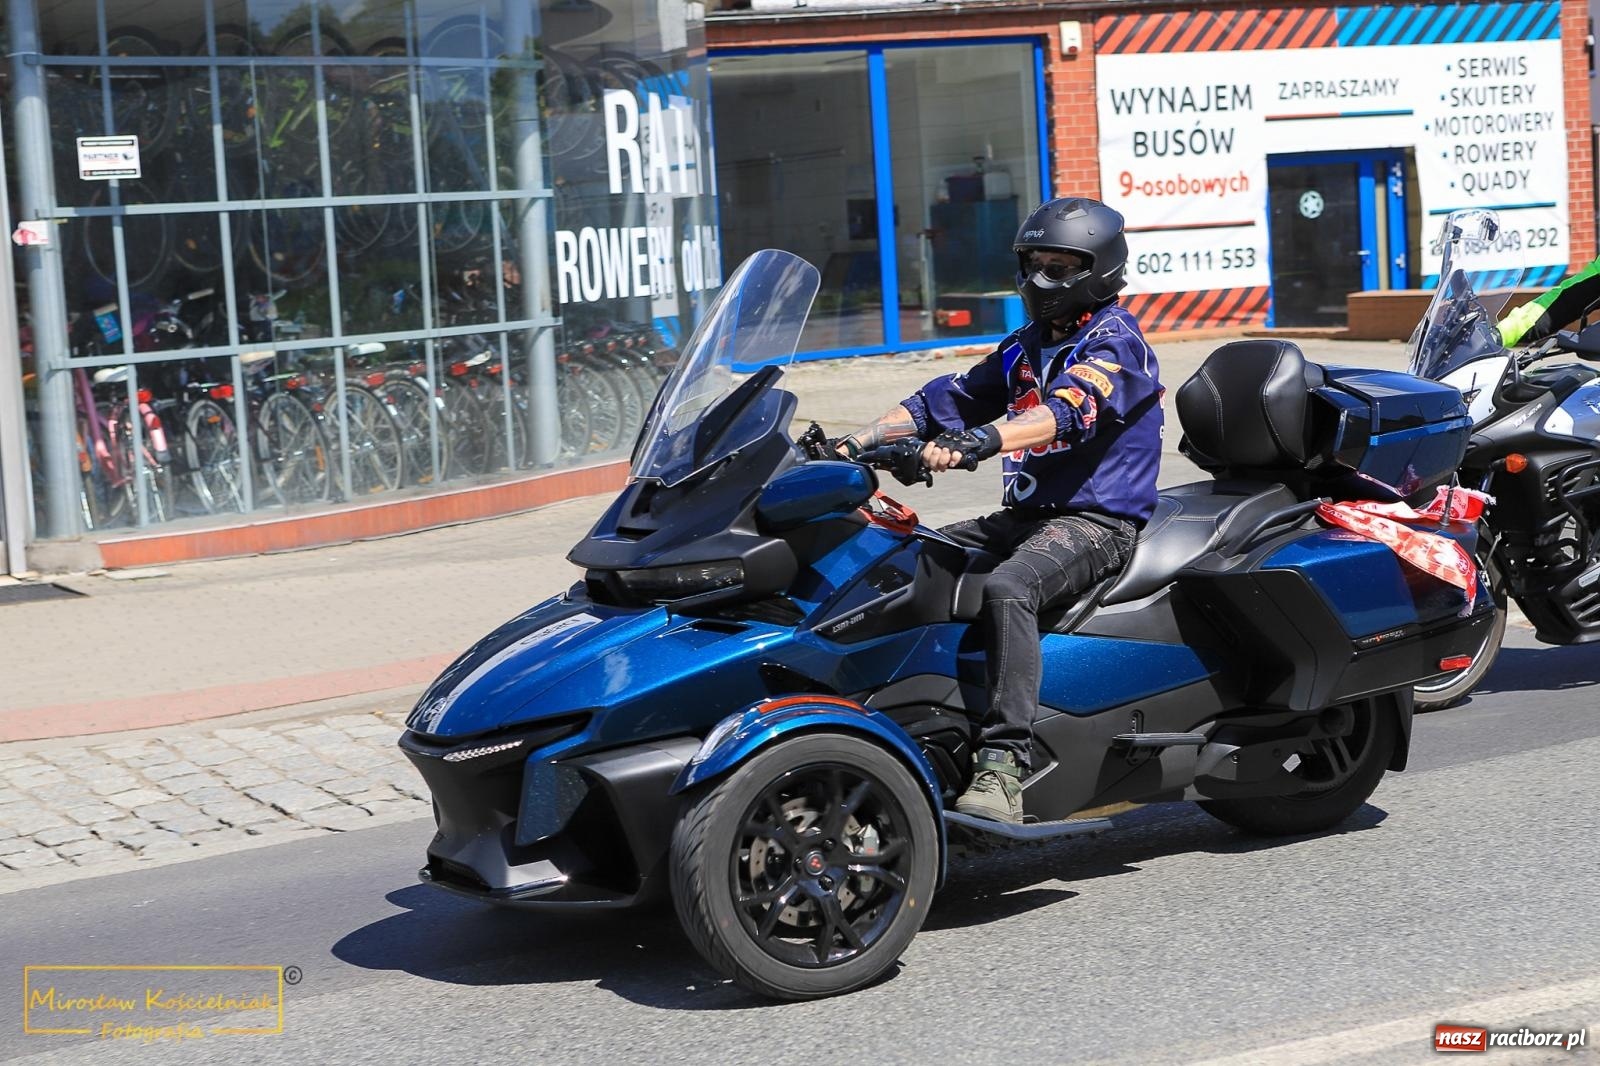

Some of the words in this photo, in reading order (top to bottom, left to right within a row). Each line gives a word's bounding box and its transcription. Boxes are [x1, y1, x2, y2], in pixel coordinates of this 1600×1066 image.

[1457, 56, 1528, 78] SERWIS
[1110, 83, 1253, 115] WYNAJEM
[1278, 78, 1400, 101] ZAPRASZAMY
[1450, 84, 1537, 107] SKUTERY
[1434, 111, 1555, 137] MOTOROWERY
[1133, 120, 1235, 158] BUSÓW
[1454, 141, 1537, 165] ROWERY
[1119, 170, 1250, 198] 9-osobowych
[1462, 169, 1532, 195] QUADY
[1527, 227, 1559, 248] 292
[554, 226, 674, 304] ROWERY
[1136, 252, 1173, 275] 602
[1180, 249, 1212, 272] 111
[1221, 247, 1256, 269] 553
